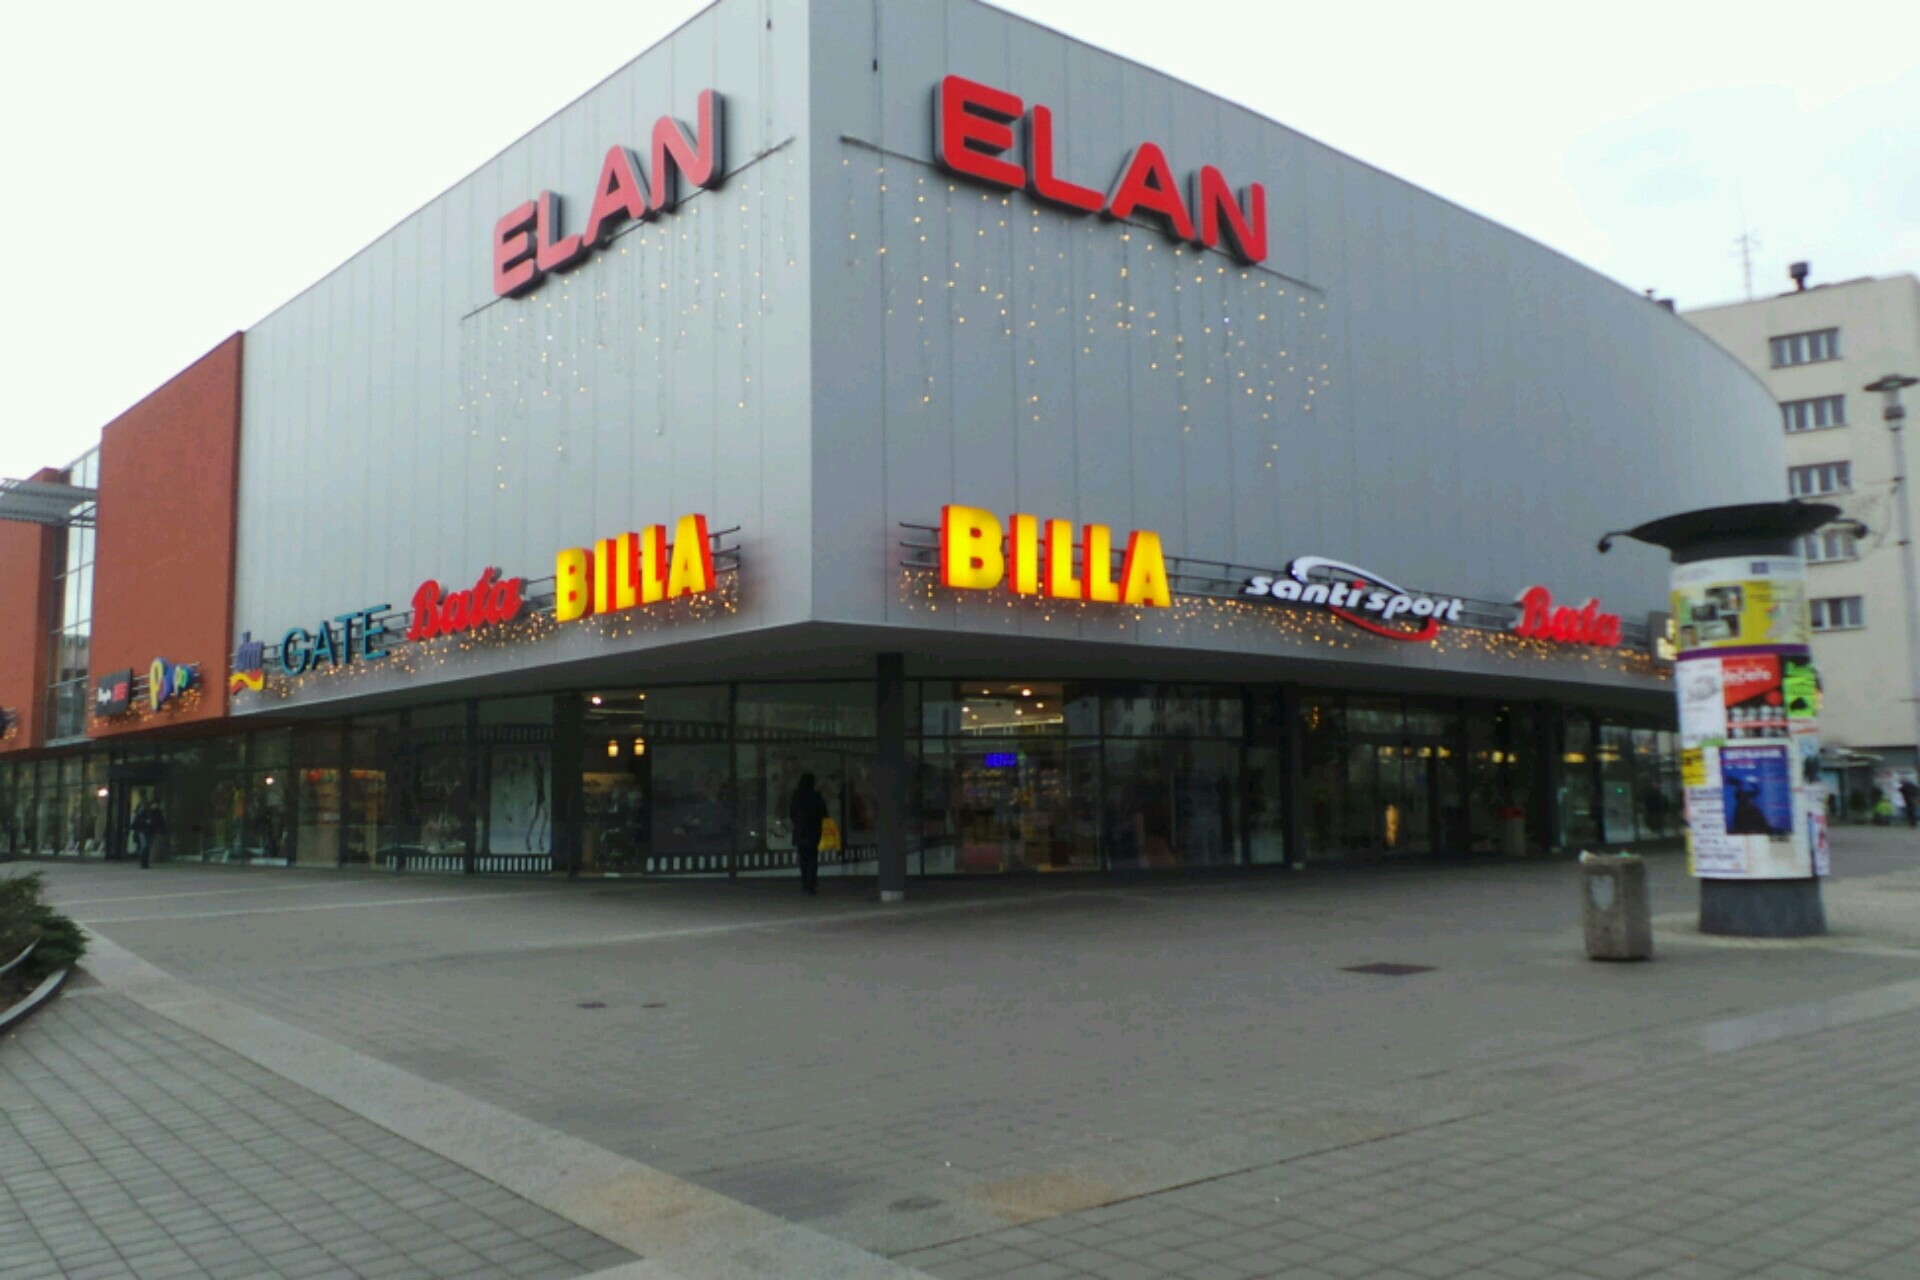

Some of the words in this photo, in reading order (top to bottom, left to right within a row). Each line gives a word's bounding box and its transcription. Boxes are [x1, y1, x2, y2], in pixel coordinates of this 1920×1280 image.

[493, 89, 724, 297] ELAN
[934, 74, 1267, 264] ELAN
[556, 513, 716, 622] BILLA
[940, 504, 1172, 608] BILLA
[279, 604, 392, 677] GATE
